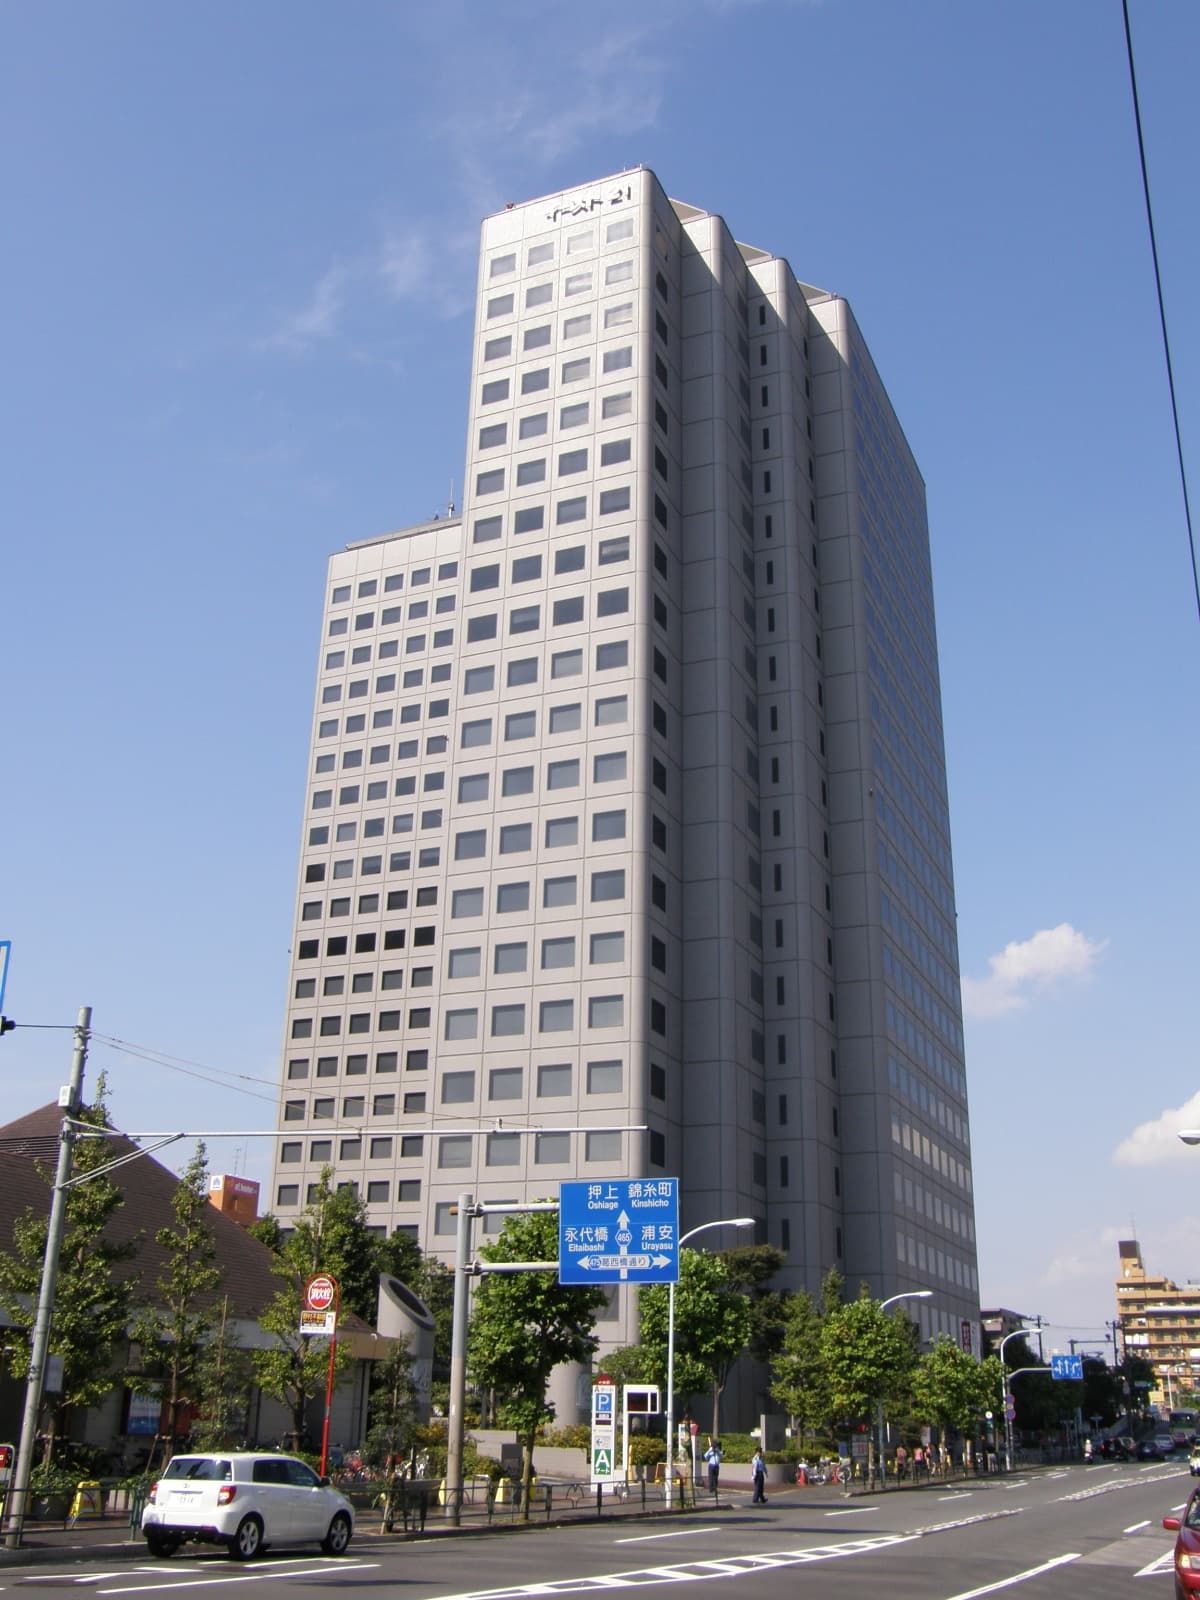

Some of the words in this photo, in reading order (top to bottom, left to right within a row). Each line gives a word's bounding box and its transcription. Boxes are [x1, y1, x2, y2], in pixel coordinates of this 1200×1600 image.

[588, 1185, 619, 1200] 押上
[628, 1182, 672, 1198] 錦糸町
[588, 1201, 619, 1210] Oshiage
[631, 1199, 669, 1208] Kinshicho
[565, 1227, 608, 1242] 永代橋
[617, 1233, 630, 1242] 465
[641, 1225, 673, 1241] 浦安
[568, 1243, 605, 1252] Eitaibashi
[641, 1242, 673, 1252] Urayasu
[598, 1394, 610, 1411] P
[595, 1450, 610, 1467] A
